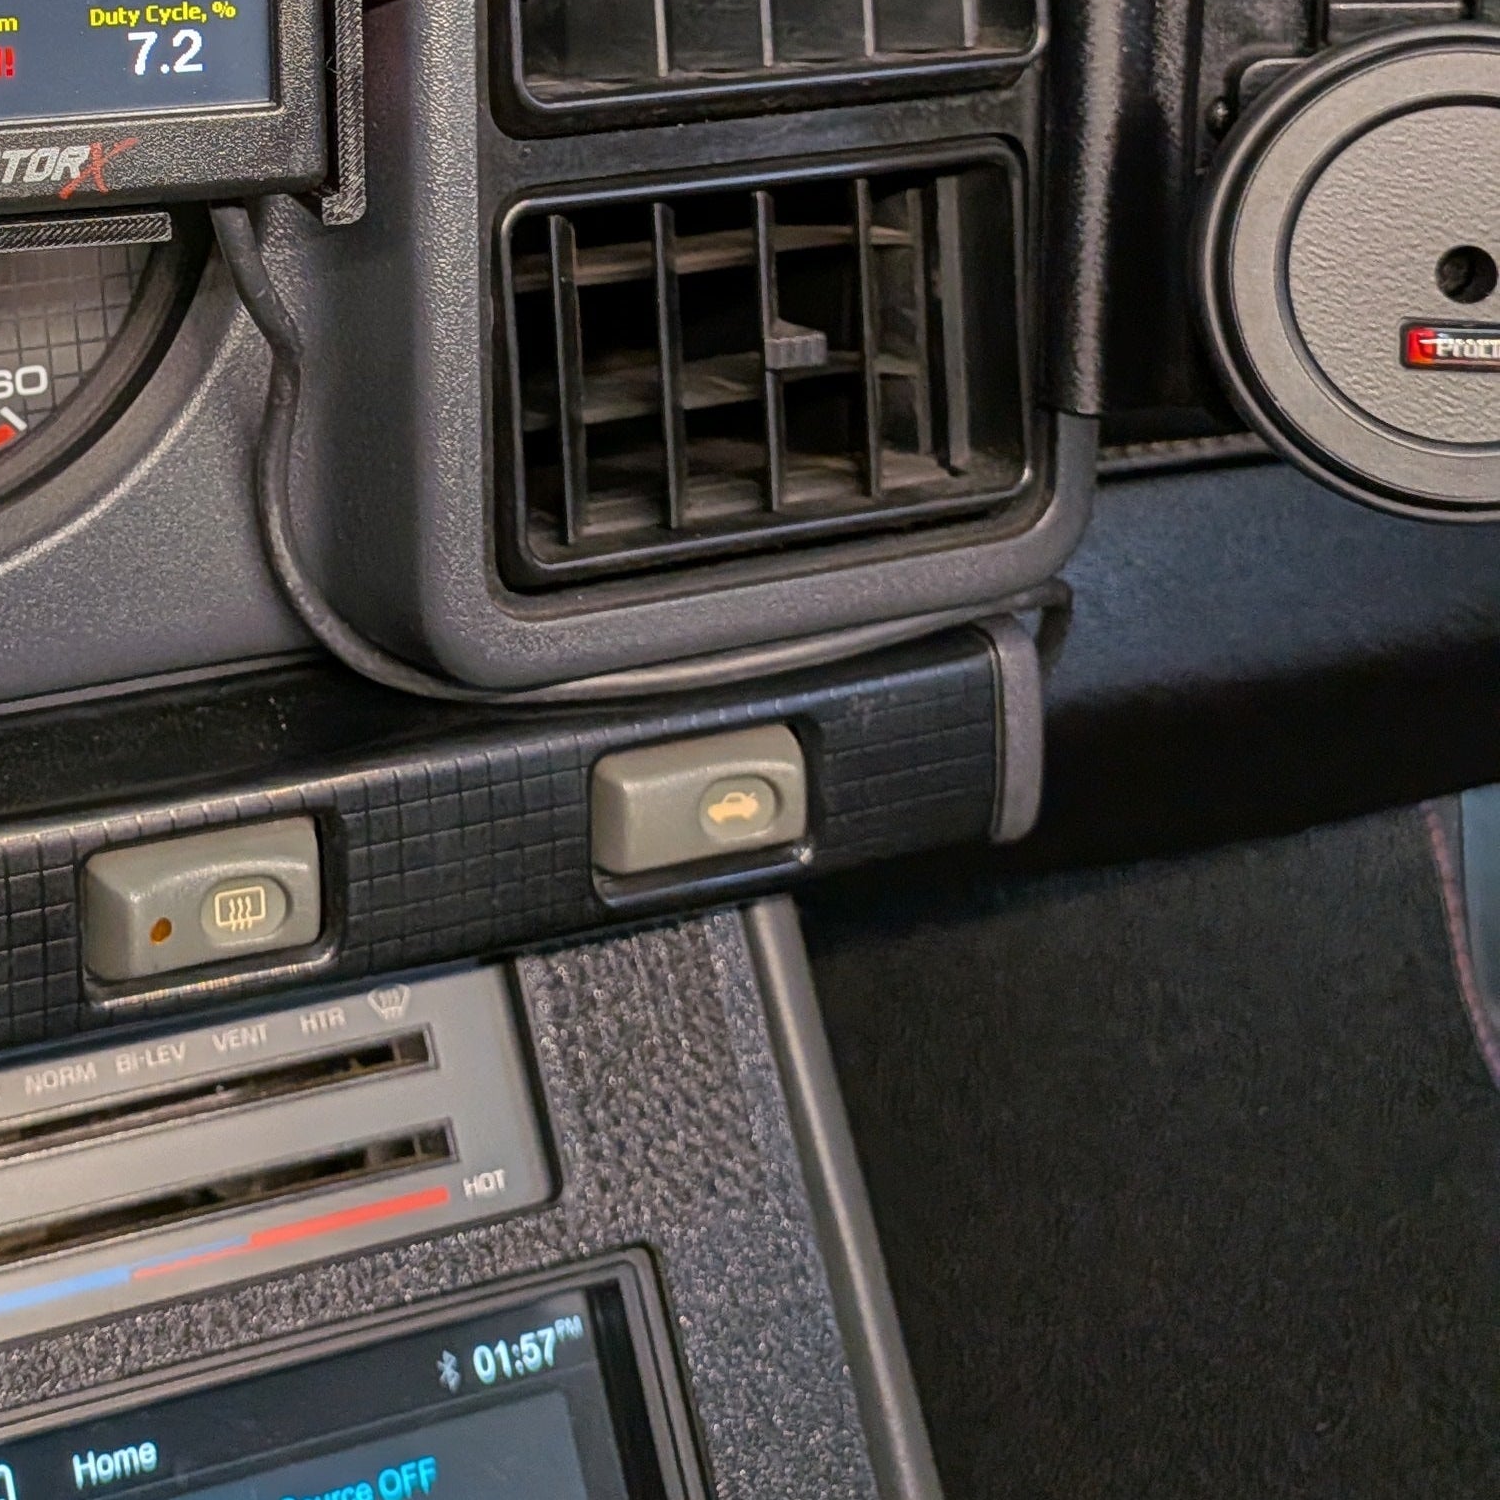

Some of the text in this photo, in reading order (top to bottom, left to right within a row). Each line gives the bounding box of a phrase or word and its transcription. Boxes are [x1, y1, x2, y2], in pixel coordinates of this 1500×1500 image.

[89, 0, 236, 28] Duty Cycle, %
[127, 28, 203, 76] 7.2
[23, 1061, 97, 1095] NORM
[114, 1041, 188, 1076] BI-LEV
[210, 1022, 269, 1052] VENT
[299, 1006, 347, 1035] HTR
[462, 1168, 508, 1200] HOT
[472, 1326, 557, 1385] 01:57
[71, 1441, 159, 1489] Home
[377, 1455, 437, 1500] OFF
